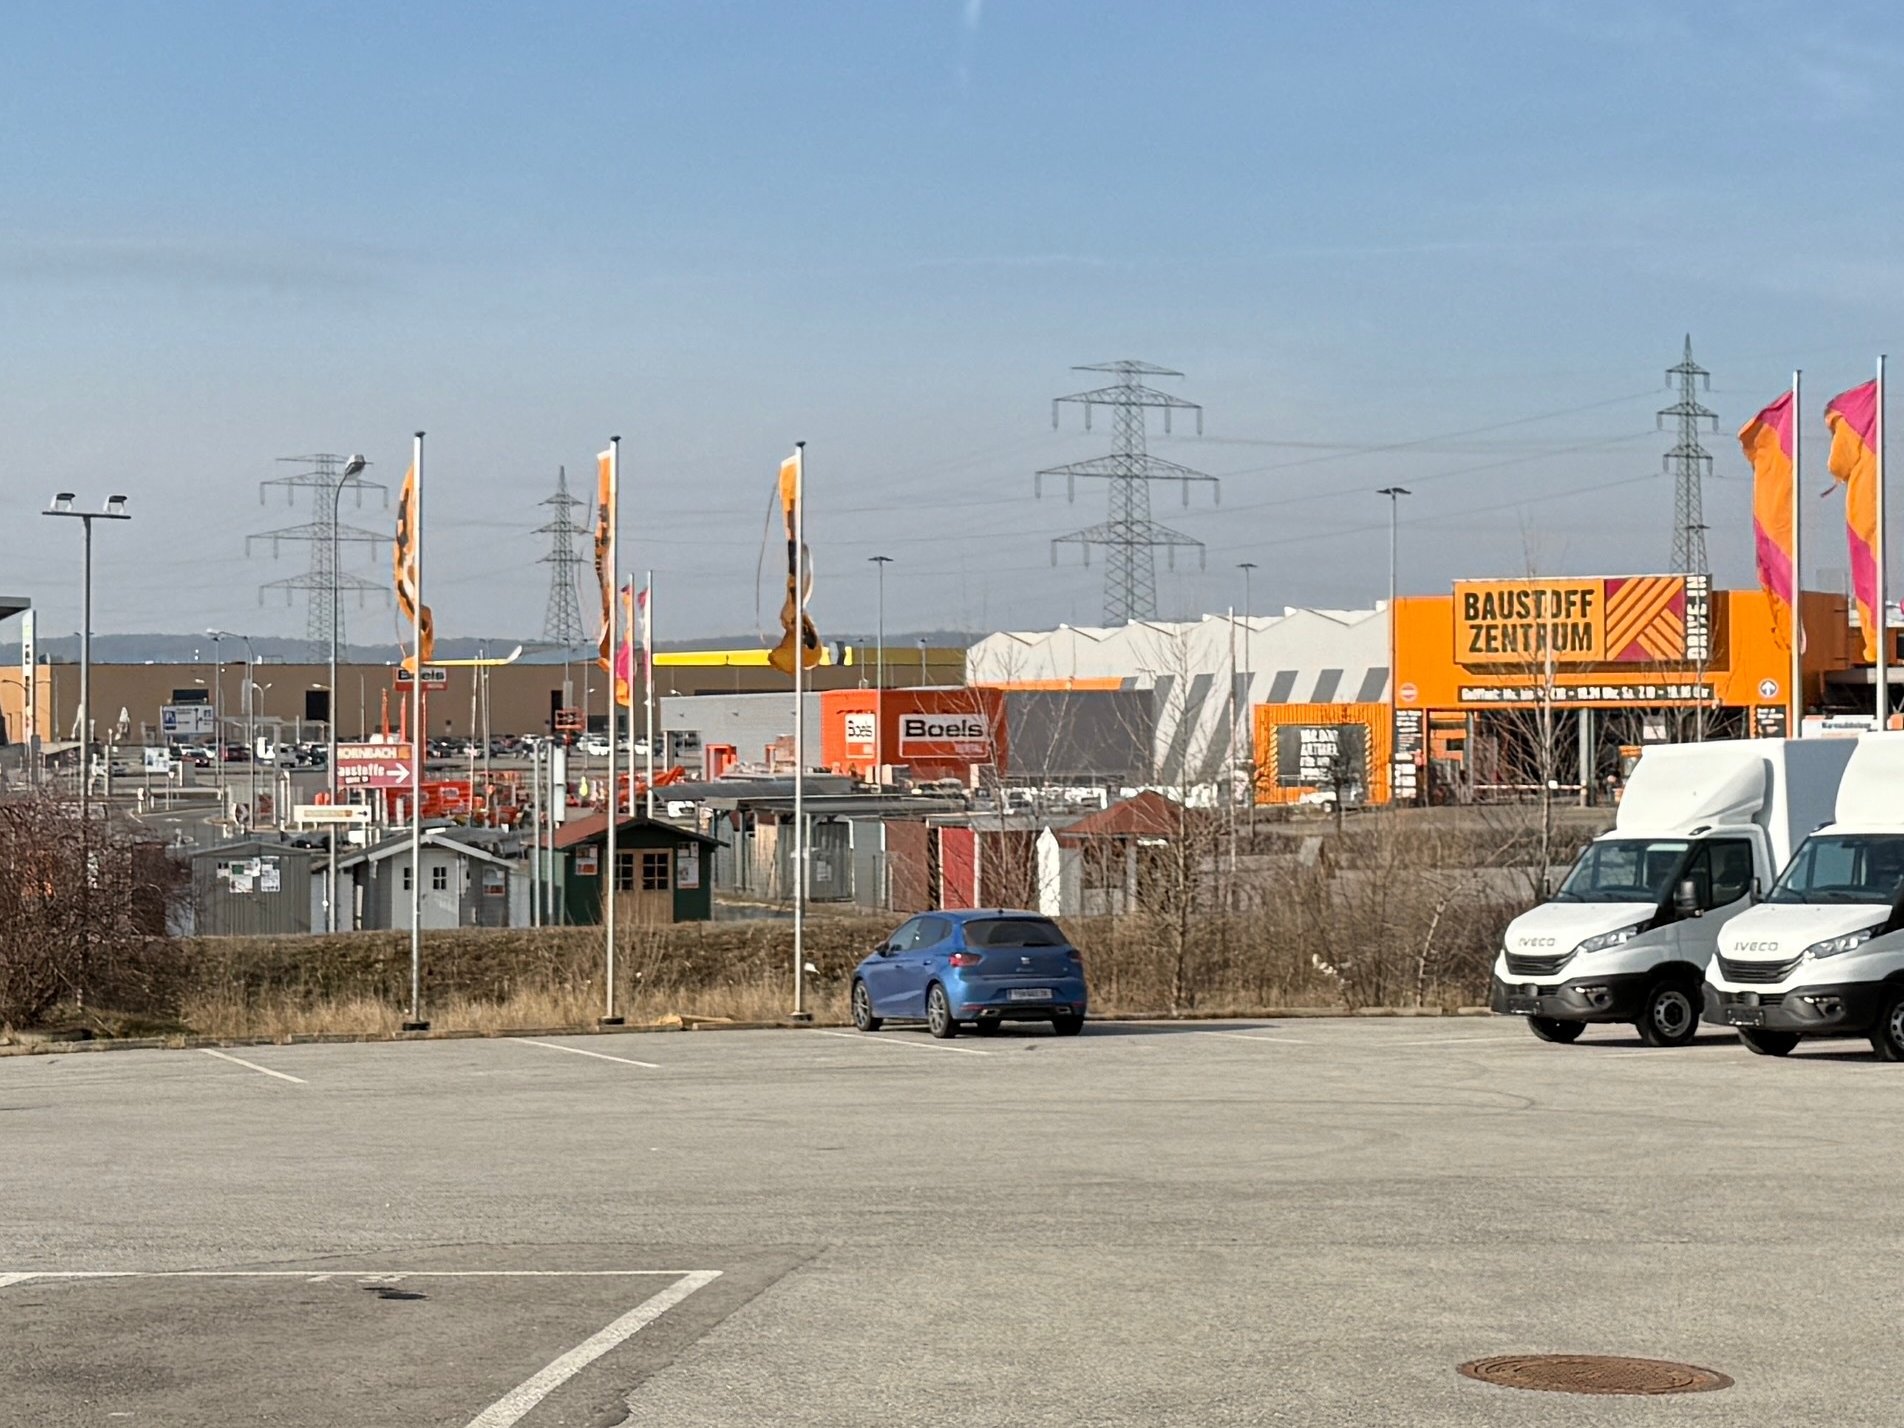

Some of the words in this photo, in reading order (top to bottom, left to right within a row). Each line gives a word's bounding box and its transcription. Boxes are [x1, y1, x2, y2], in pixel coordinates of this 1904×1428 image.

[1464, 588, 1596, 621] BAUSTOFF
[1469, 621, 1593, 653] ZENTRUM
[398, 669, 445, 681] Bels
[904, 719, 984, 738] Boels
[337, 763, 385, 776] austoffe
[1518, 937, 1556, 947] IVECO
[1734, 941, 1779, 952] IVECO
